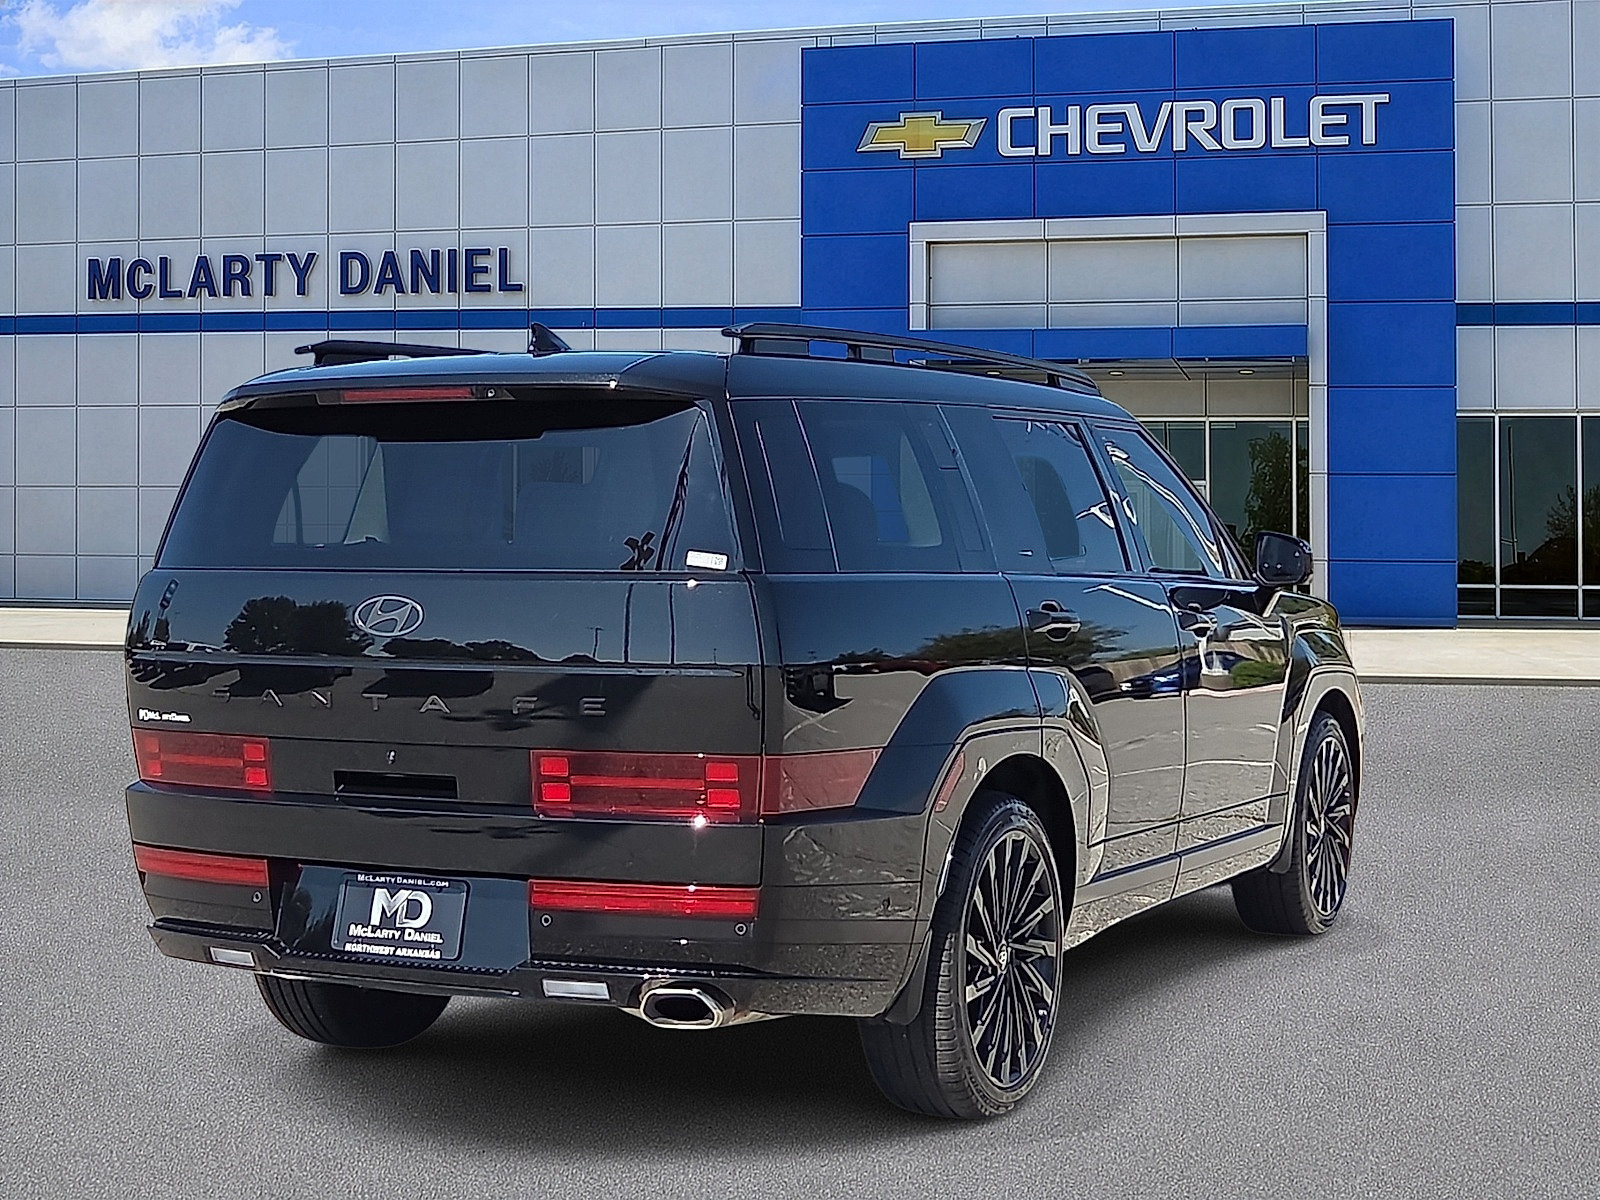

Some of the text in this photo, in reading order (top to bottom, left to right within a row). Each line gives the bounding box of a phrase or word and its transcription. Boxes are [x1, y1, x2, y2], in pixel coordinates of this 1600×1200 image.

[996, 93, 1390, 157] CHEVROLET
[338, 246, 525, 296] DANIEL
[512, 696, 606, 717] FE
[370, 888, 432, 928] MD
[403, 928, 444, 943] DANIEL
